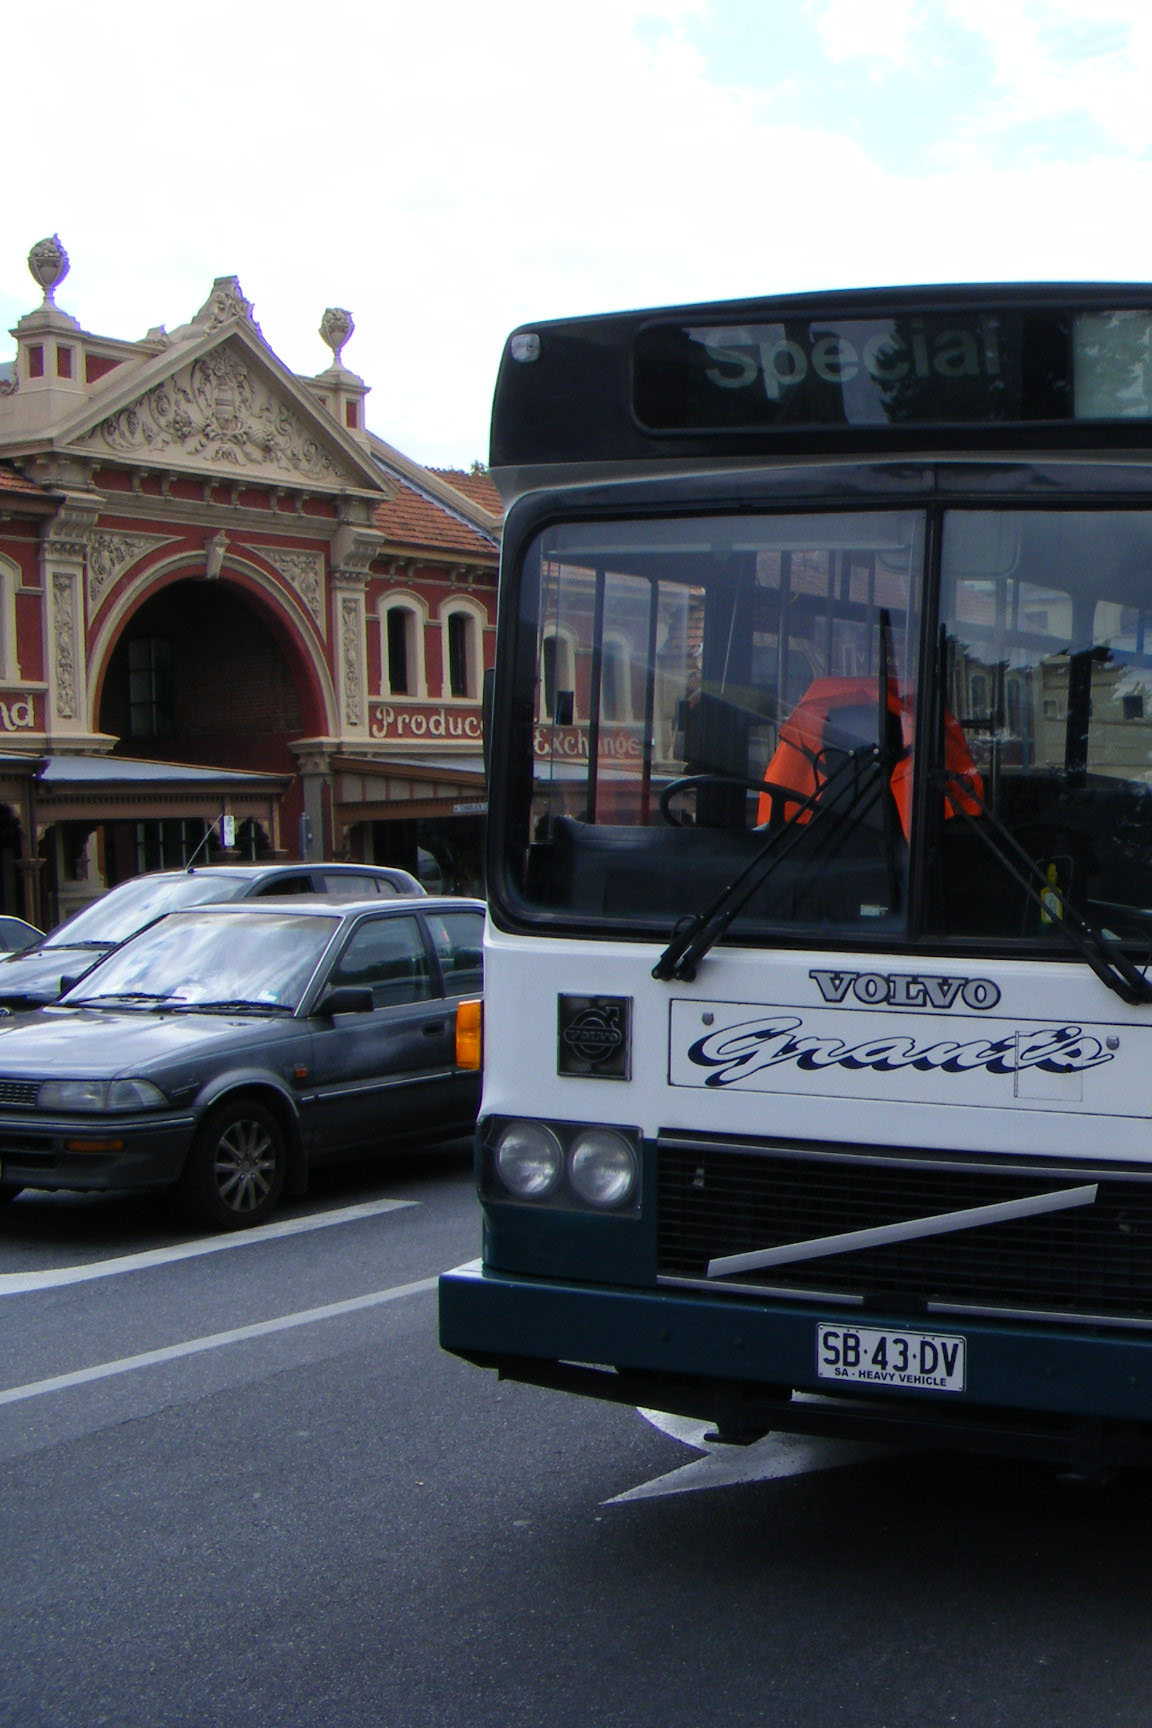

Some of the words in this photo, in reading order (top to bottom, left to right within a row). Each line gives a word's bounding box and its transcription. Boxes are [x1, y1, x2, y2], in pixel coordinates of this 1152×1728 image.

[704, 317, 1002, 400] Special
[372, 706, 483, 738] Produc
[809, 970, 1001, 1010] VOLVO
[687, 1016, 1115, 1087] Grant's
[834, 1367, 849, 1377] SA
[858, 1369, 895, 1381] HEAVY
[899, 1374, 947, 1386] VEHICLE
